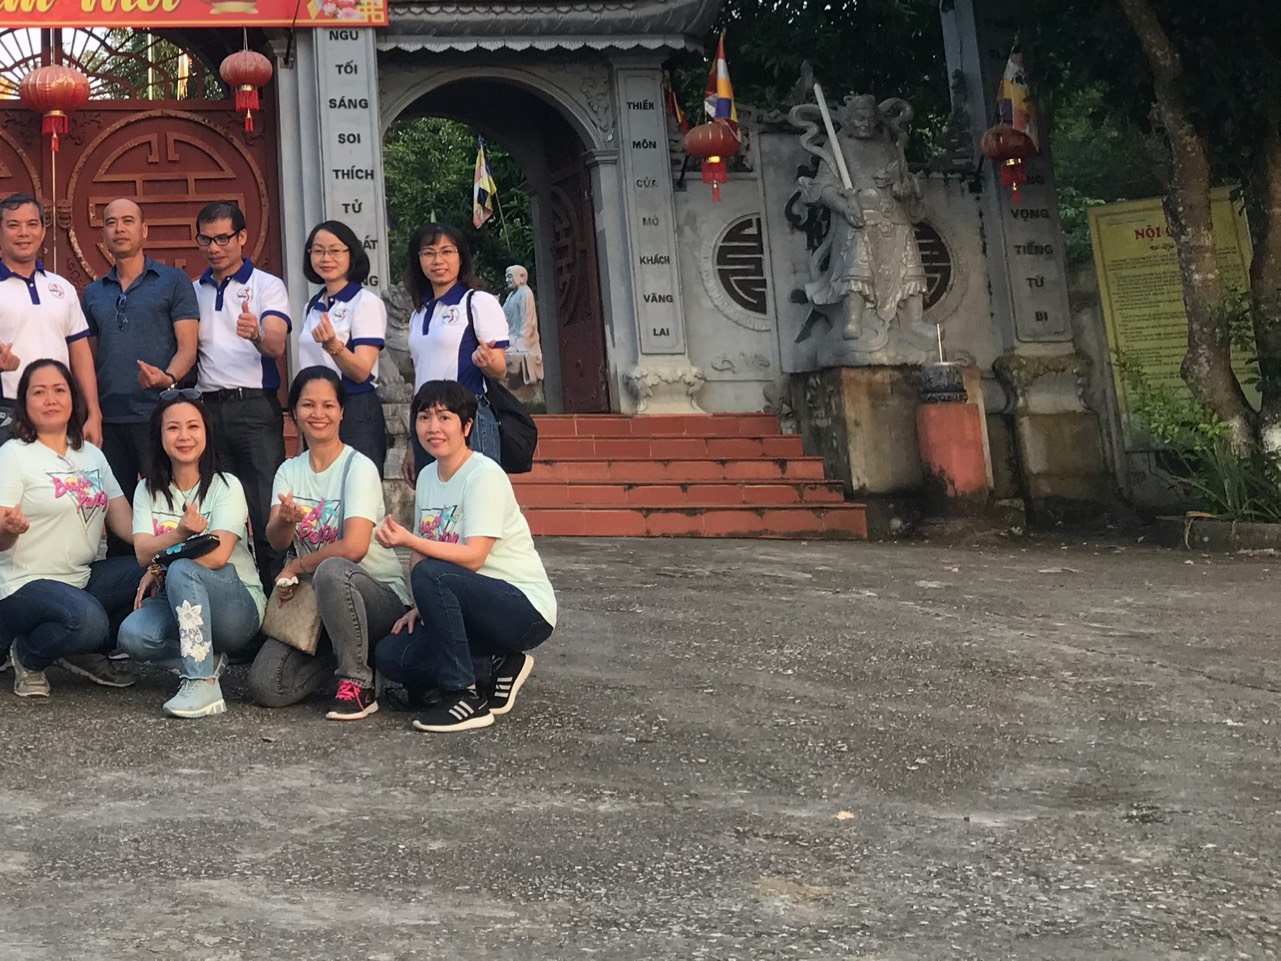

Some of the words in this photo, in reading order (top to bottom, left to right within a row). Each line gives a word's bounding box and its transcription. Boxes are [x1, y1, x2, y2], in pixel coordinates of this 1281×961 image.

[335, 60, 358, 75] TỐI
[328, 95, 369, 110] SÁNG
[337, 133, 361, 145] SOI
[632, 138, 657, 150] MÔN
[332, 166, 375, 181] THÍCH
[341, 199, 363, 214] TỬ
[639, 253, 671, 265] KHÁCH
[1035, 311, 1049, 322] BI
[652, 327, 670, 337] LAI
